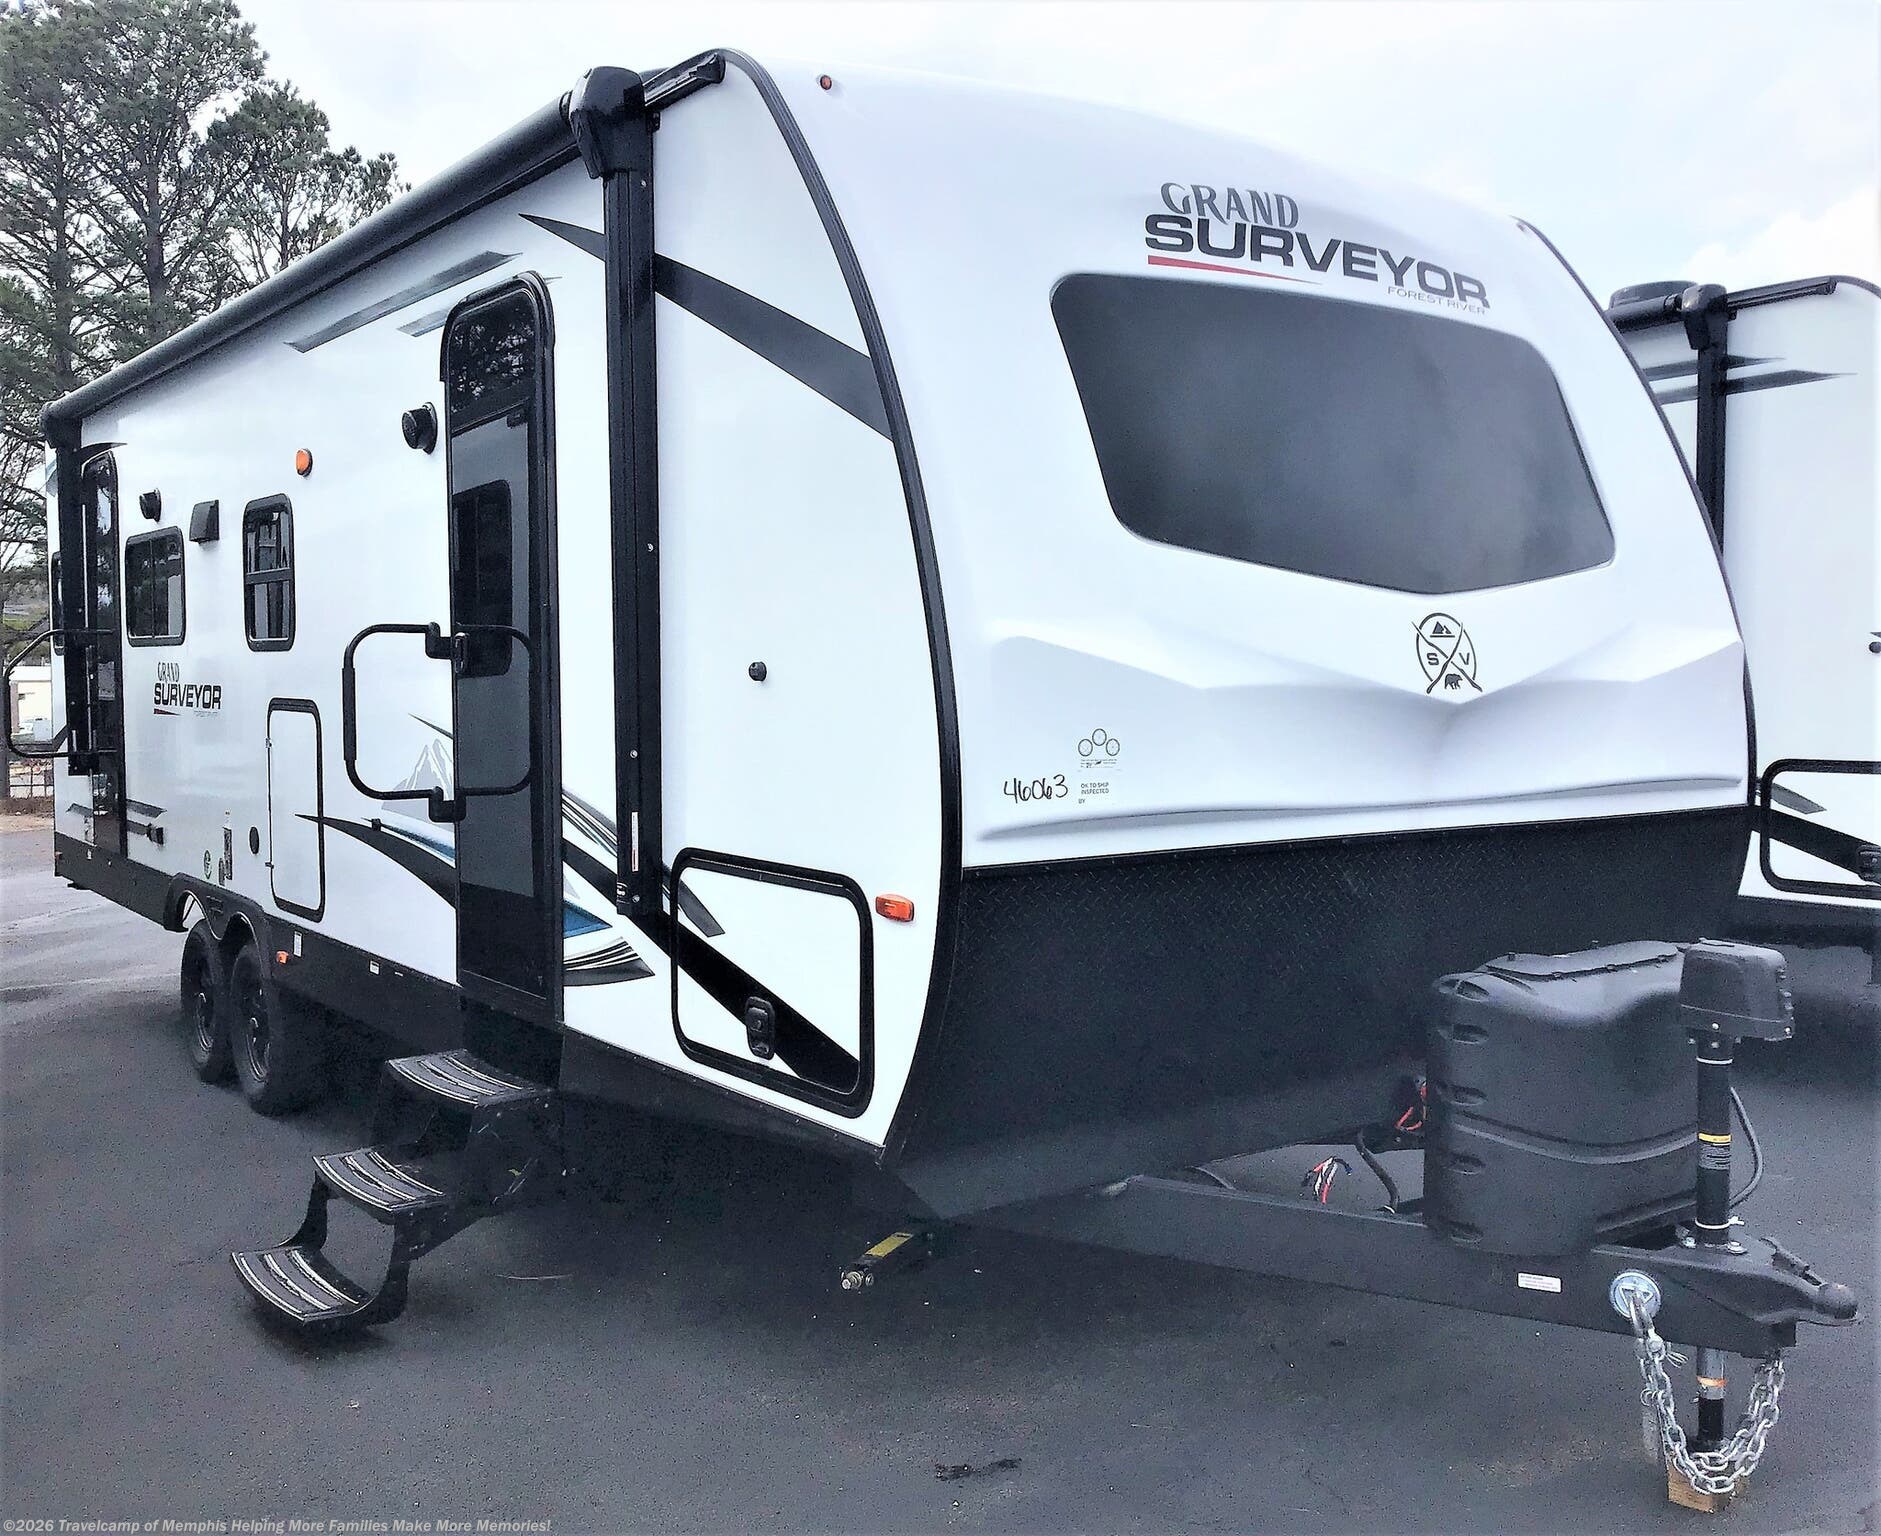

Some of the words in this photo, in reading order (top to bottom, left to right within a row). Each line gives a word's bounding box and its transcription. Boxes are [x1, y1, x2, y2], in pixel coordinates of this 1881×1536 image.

[1160, 182, 1299, 228] GRAND
[1145, 214, 1490, 309] SURVEYOR
[1387, 286, 1443, 304] FOREST
[1447, 299, 1485, 315] RIVER
[157, 661, 180, 683] GRAND
[1426, 652, 1439, 666] S
[1458, 652, 1470, 666] V
[153, 682, 222, 710] SURVEYOR
[1003, 774, 1068, 804] 46063
